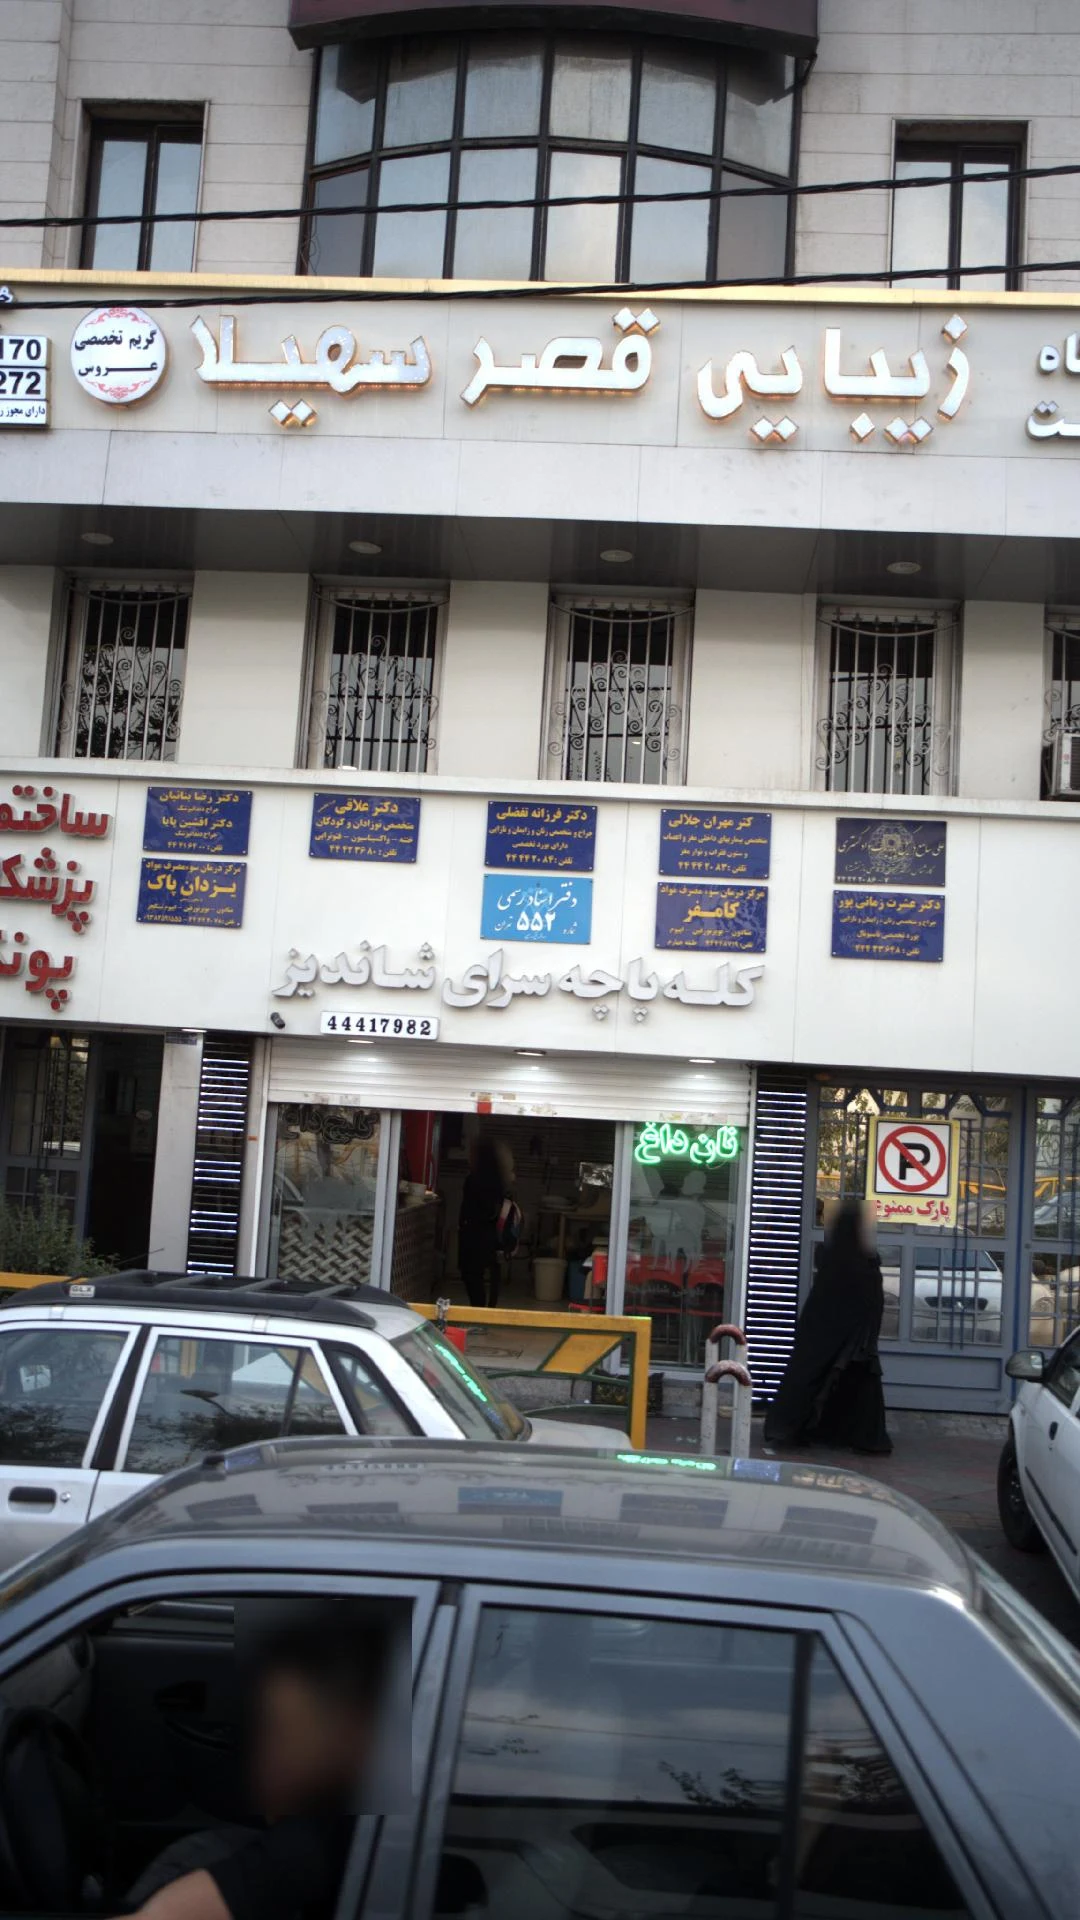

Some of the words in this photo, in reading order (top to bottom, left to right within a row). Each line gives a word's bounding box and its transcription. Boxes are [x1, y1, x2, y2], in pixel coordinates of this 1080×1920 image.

[74, 330, 123, 351] تخصصی
[461, 307, 660, 406] قصر
[78, 362, 158, 377] عروس
[190, 313, 432, 427] سهیلا
[697, 312, 970, 442] زیبایی
[195, 792, 212, 803] رضا
[216, 793, 239, 803] دکتر
[372, 801, 398, 816] دکتر
[531, 807, 562, 822] فرزانه
[315, 817, 345, 828] کودکان
[564, 810, 587, 823] دکتر
[668, 813, 700, 828] جلالی
[210, 819, 233, 830] دکتر
[353, 820, 382, 830] نوزادان
[383, 821, 414, 832] متخصص
[146, 861, 161, 871] مواد
[200, 863, 223, 873] درمان
[224, 865, 240, 875] مرکز
[147, 874, 177, 896] پاک
[180, 876, 237, 898] یزدان
[660, 885, 677, 896] مواد
[497, 888, 525, 910] رسمی
[527, 888, 553, 906] اسناد
[547, 881, 578, 912] دفتر
[720, 887, 744, 899] درمان
[745, 888, 765, 900] مرکز
[839, 898, 854, 909] پور
[918, 899, 941, 913] دکتر
[516, 911, 556, 931] ۵۵۲
[272, 940, 436, 999] شاندیز
[442, 948, 552, 1009] سرای
[662, 961, 765, 1006] کله
[558, 956, 659, 1023] پاچه
[327, 1015, 431, 1036] 44417982
[634, 1120, 689, 1164] داغ
[690, 1124, 738, 1164] نان
[917, 1200, 950, 1222] پارک
